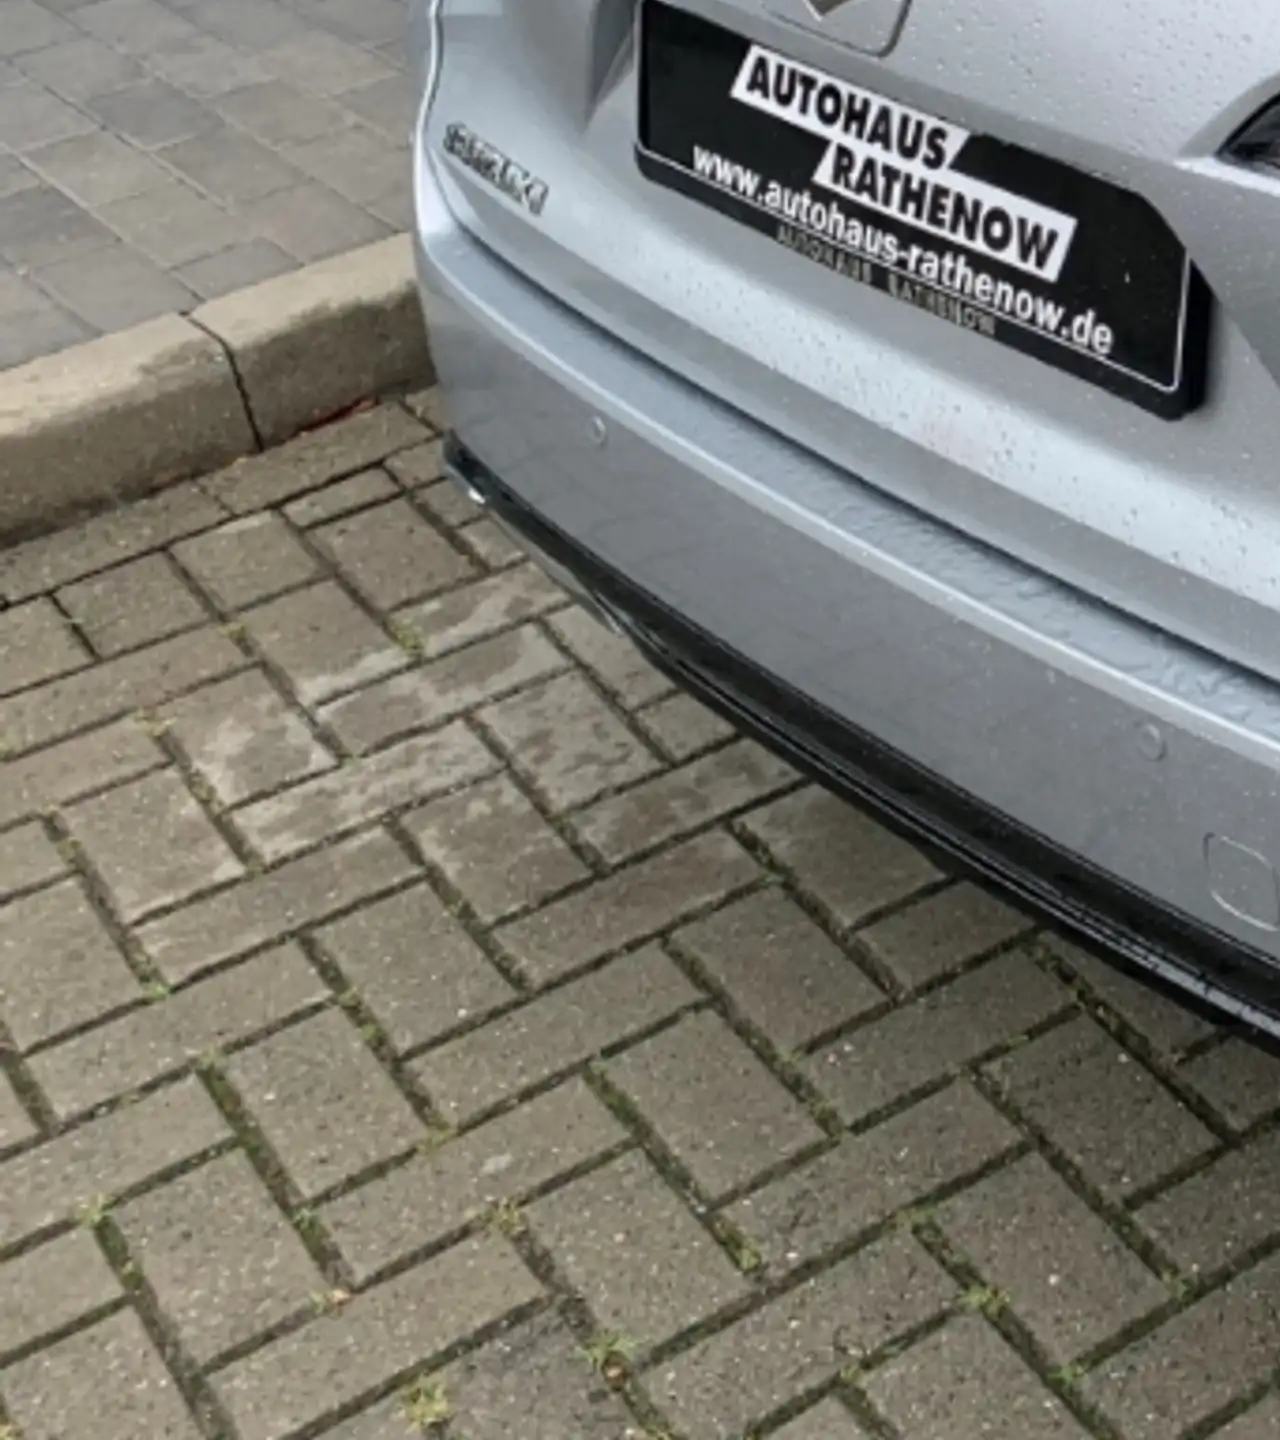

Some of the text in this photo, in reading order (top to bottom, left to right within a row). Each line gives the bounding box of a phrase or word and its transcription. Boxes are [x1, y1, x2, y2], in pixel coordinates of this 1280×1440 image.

[746, 55, 948, 170] AUTOHAUS
[693, 144, 1114, 356] www.autohaus-rathenow.de
[834, 147, 1060, 270] RATHENOW
